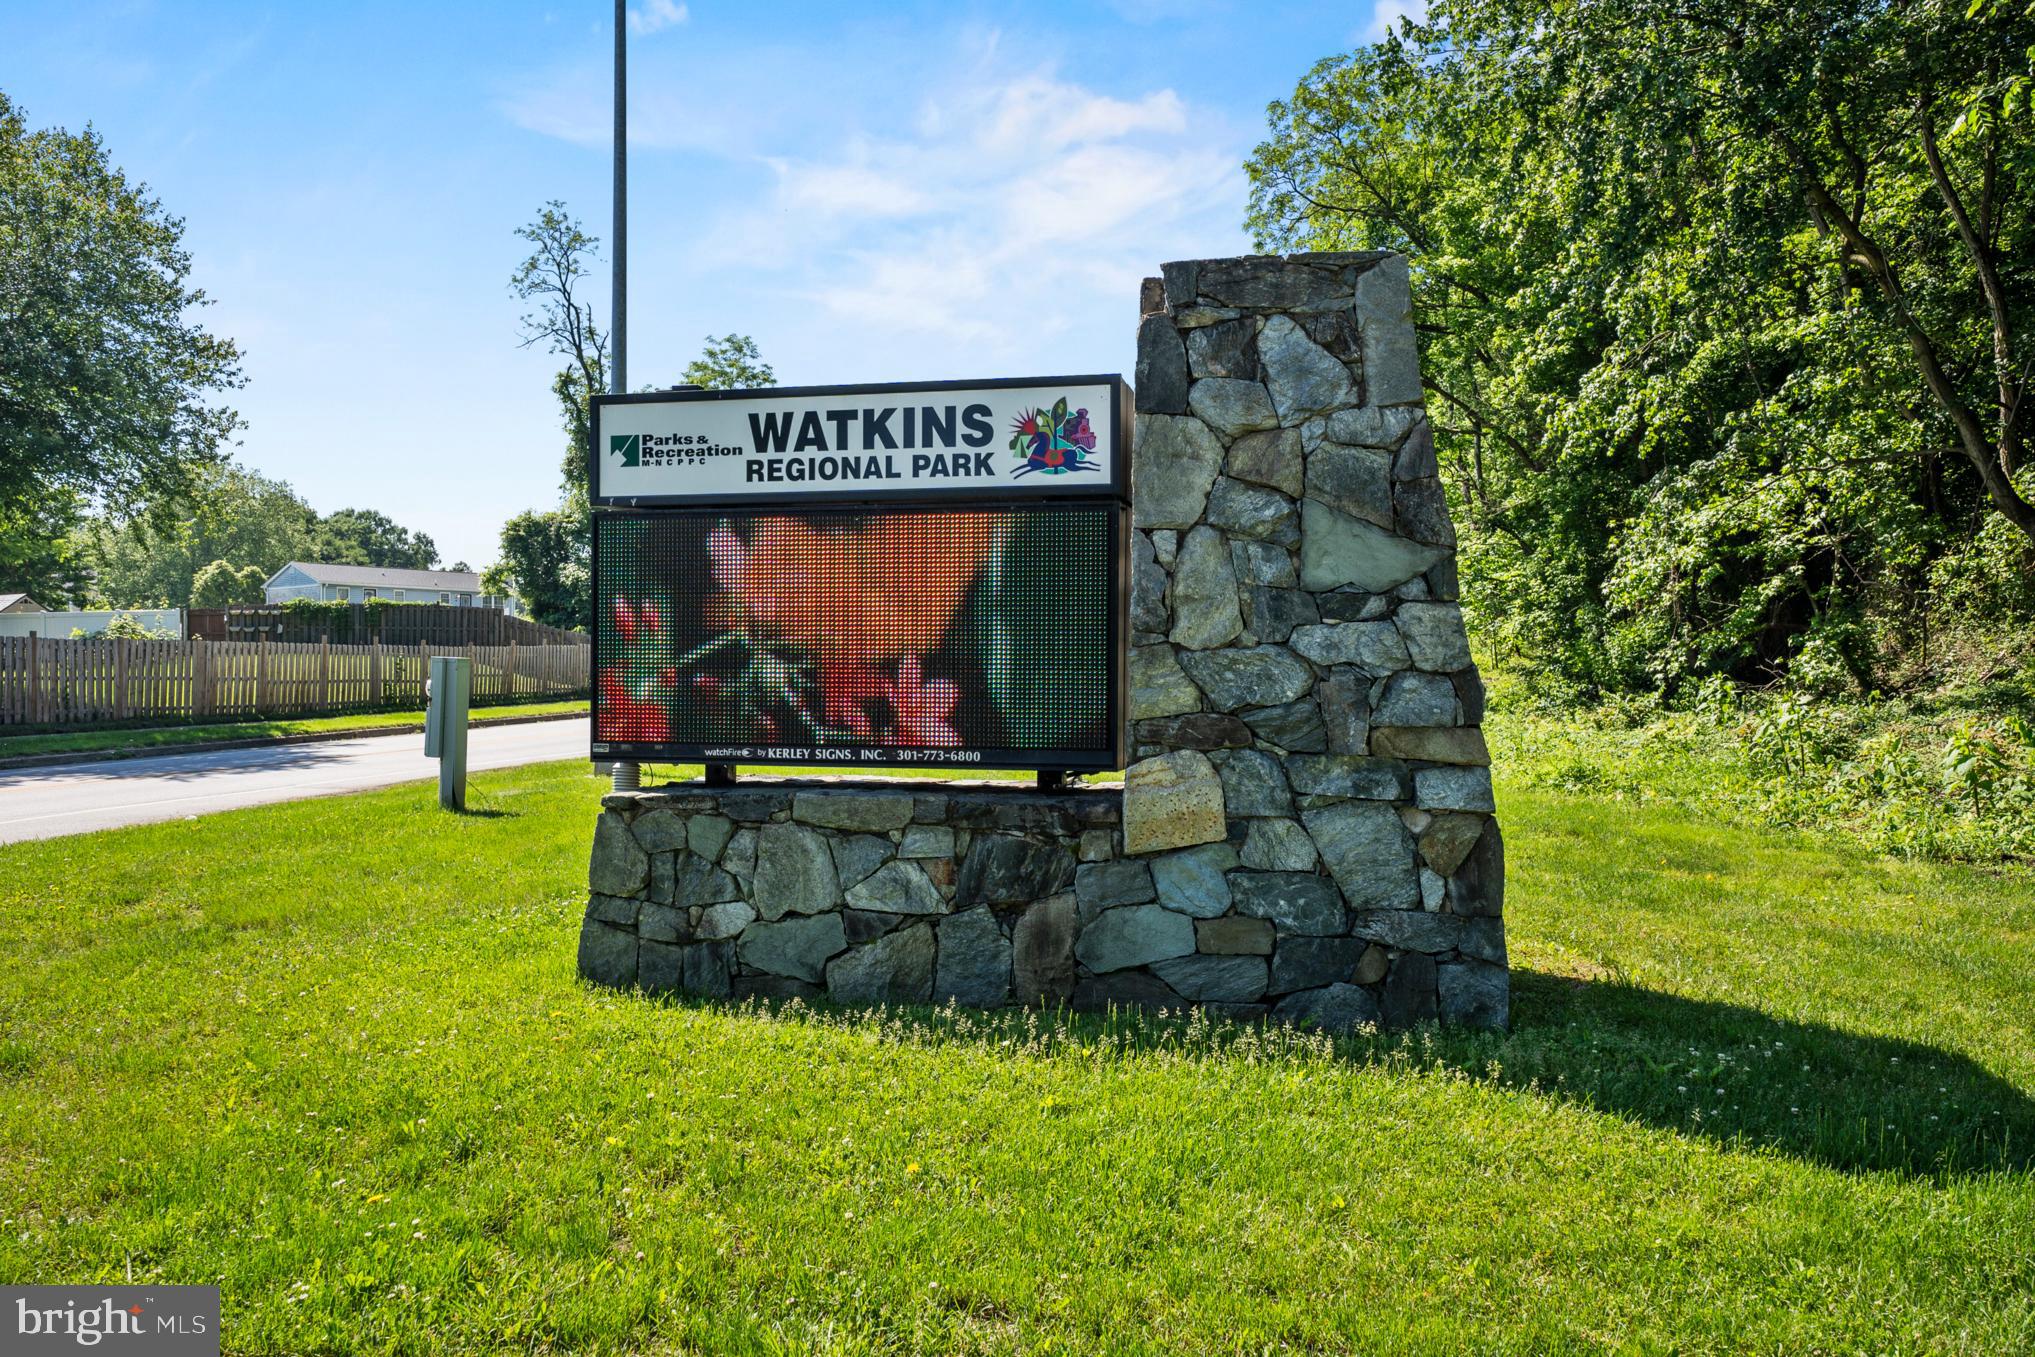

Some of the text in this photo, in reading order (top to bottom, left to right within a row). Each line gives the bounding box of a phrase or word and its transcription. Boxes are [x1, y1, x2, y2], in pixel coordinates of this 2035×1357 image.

[748, 403, 994, 453] WATKINS
[641, 433, 709, 446] Parks &
[641, 444, 743, 459] Recreation
[746, 452, 996, 482] REGIONAL PARK
[704, 748, 741, 757] watchFire
[757, 748, 767, 757] by
[768, 748, 811, 759] KERLEY
[860, 749, 887, 760] INC.
[896, 749, 981, 762] 301-773-6800
